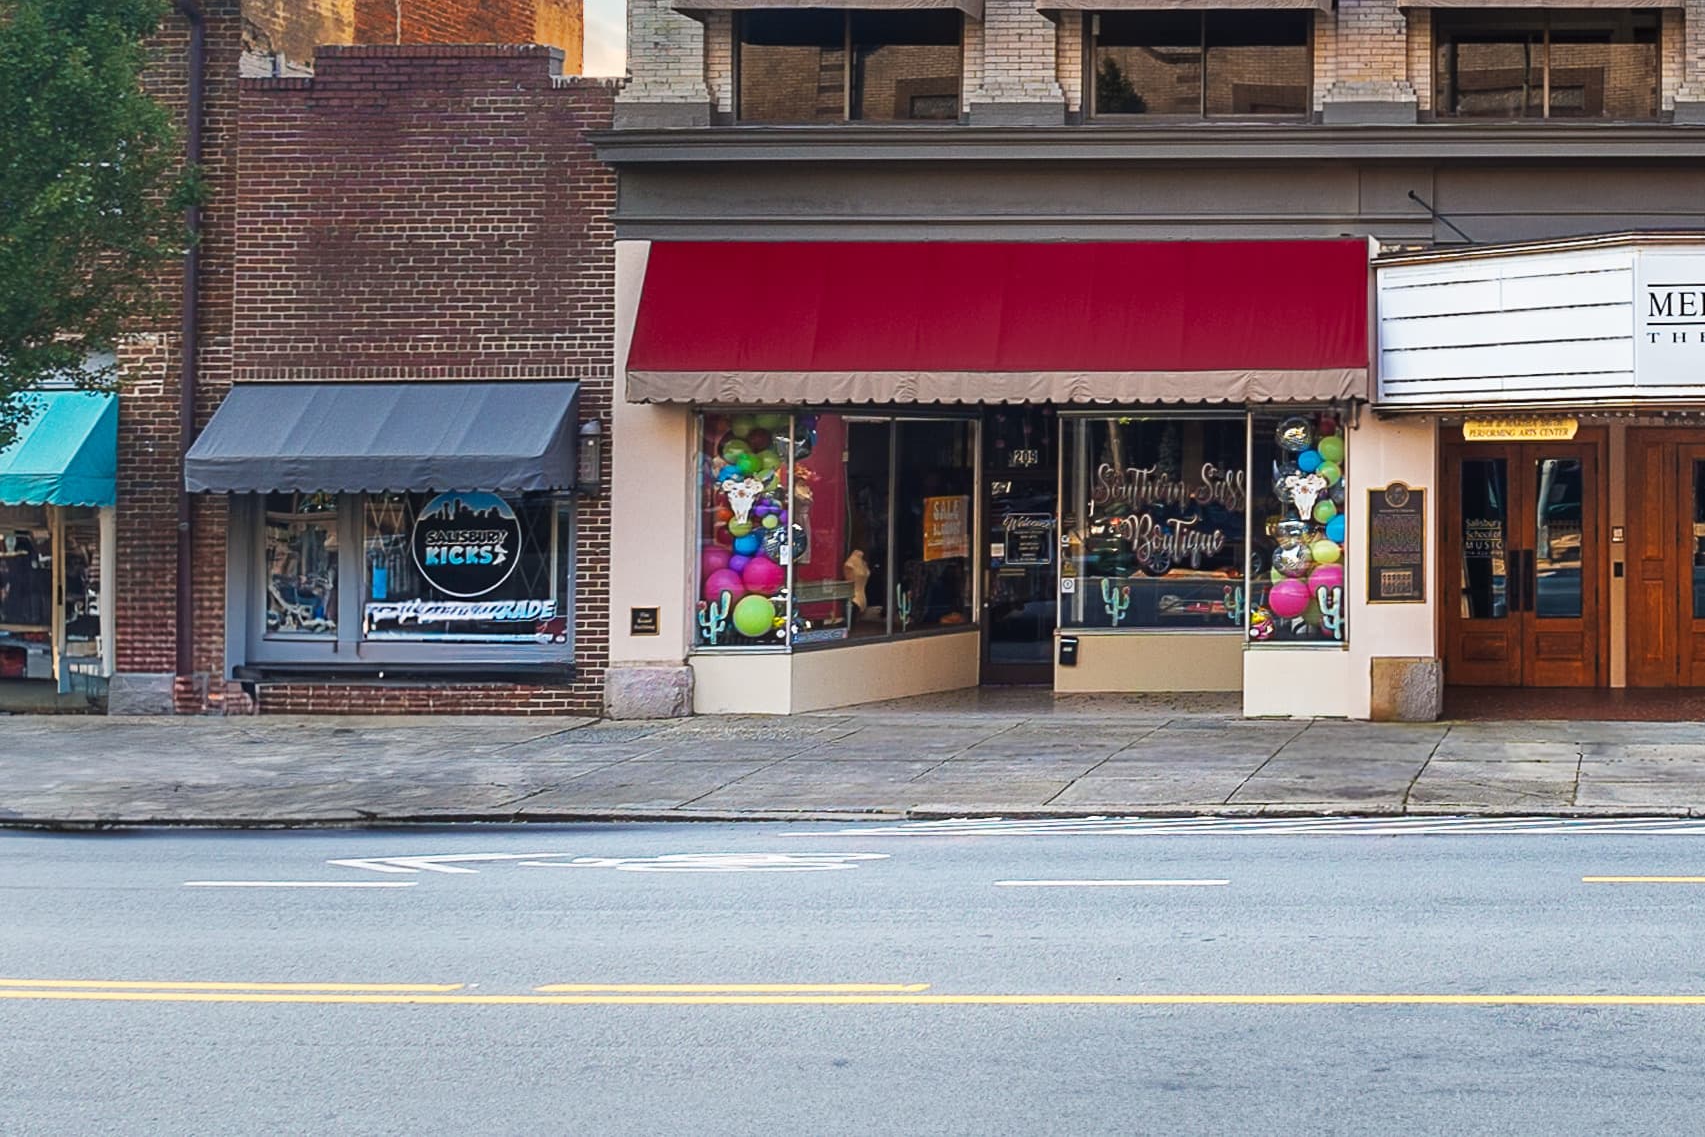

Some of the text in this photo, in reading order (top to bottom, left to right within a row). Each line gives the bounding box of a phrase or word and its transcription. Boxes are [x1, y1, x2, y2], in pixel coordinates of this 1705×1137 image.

[1469, 427, 1569, 438] PERFORMING ARTS CENTER
[425, 530, 509, 545] SALISBURY
[1120, 513, 1225, 567] Boutique
[425, 545, 494, 566] KICKS
